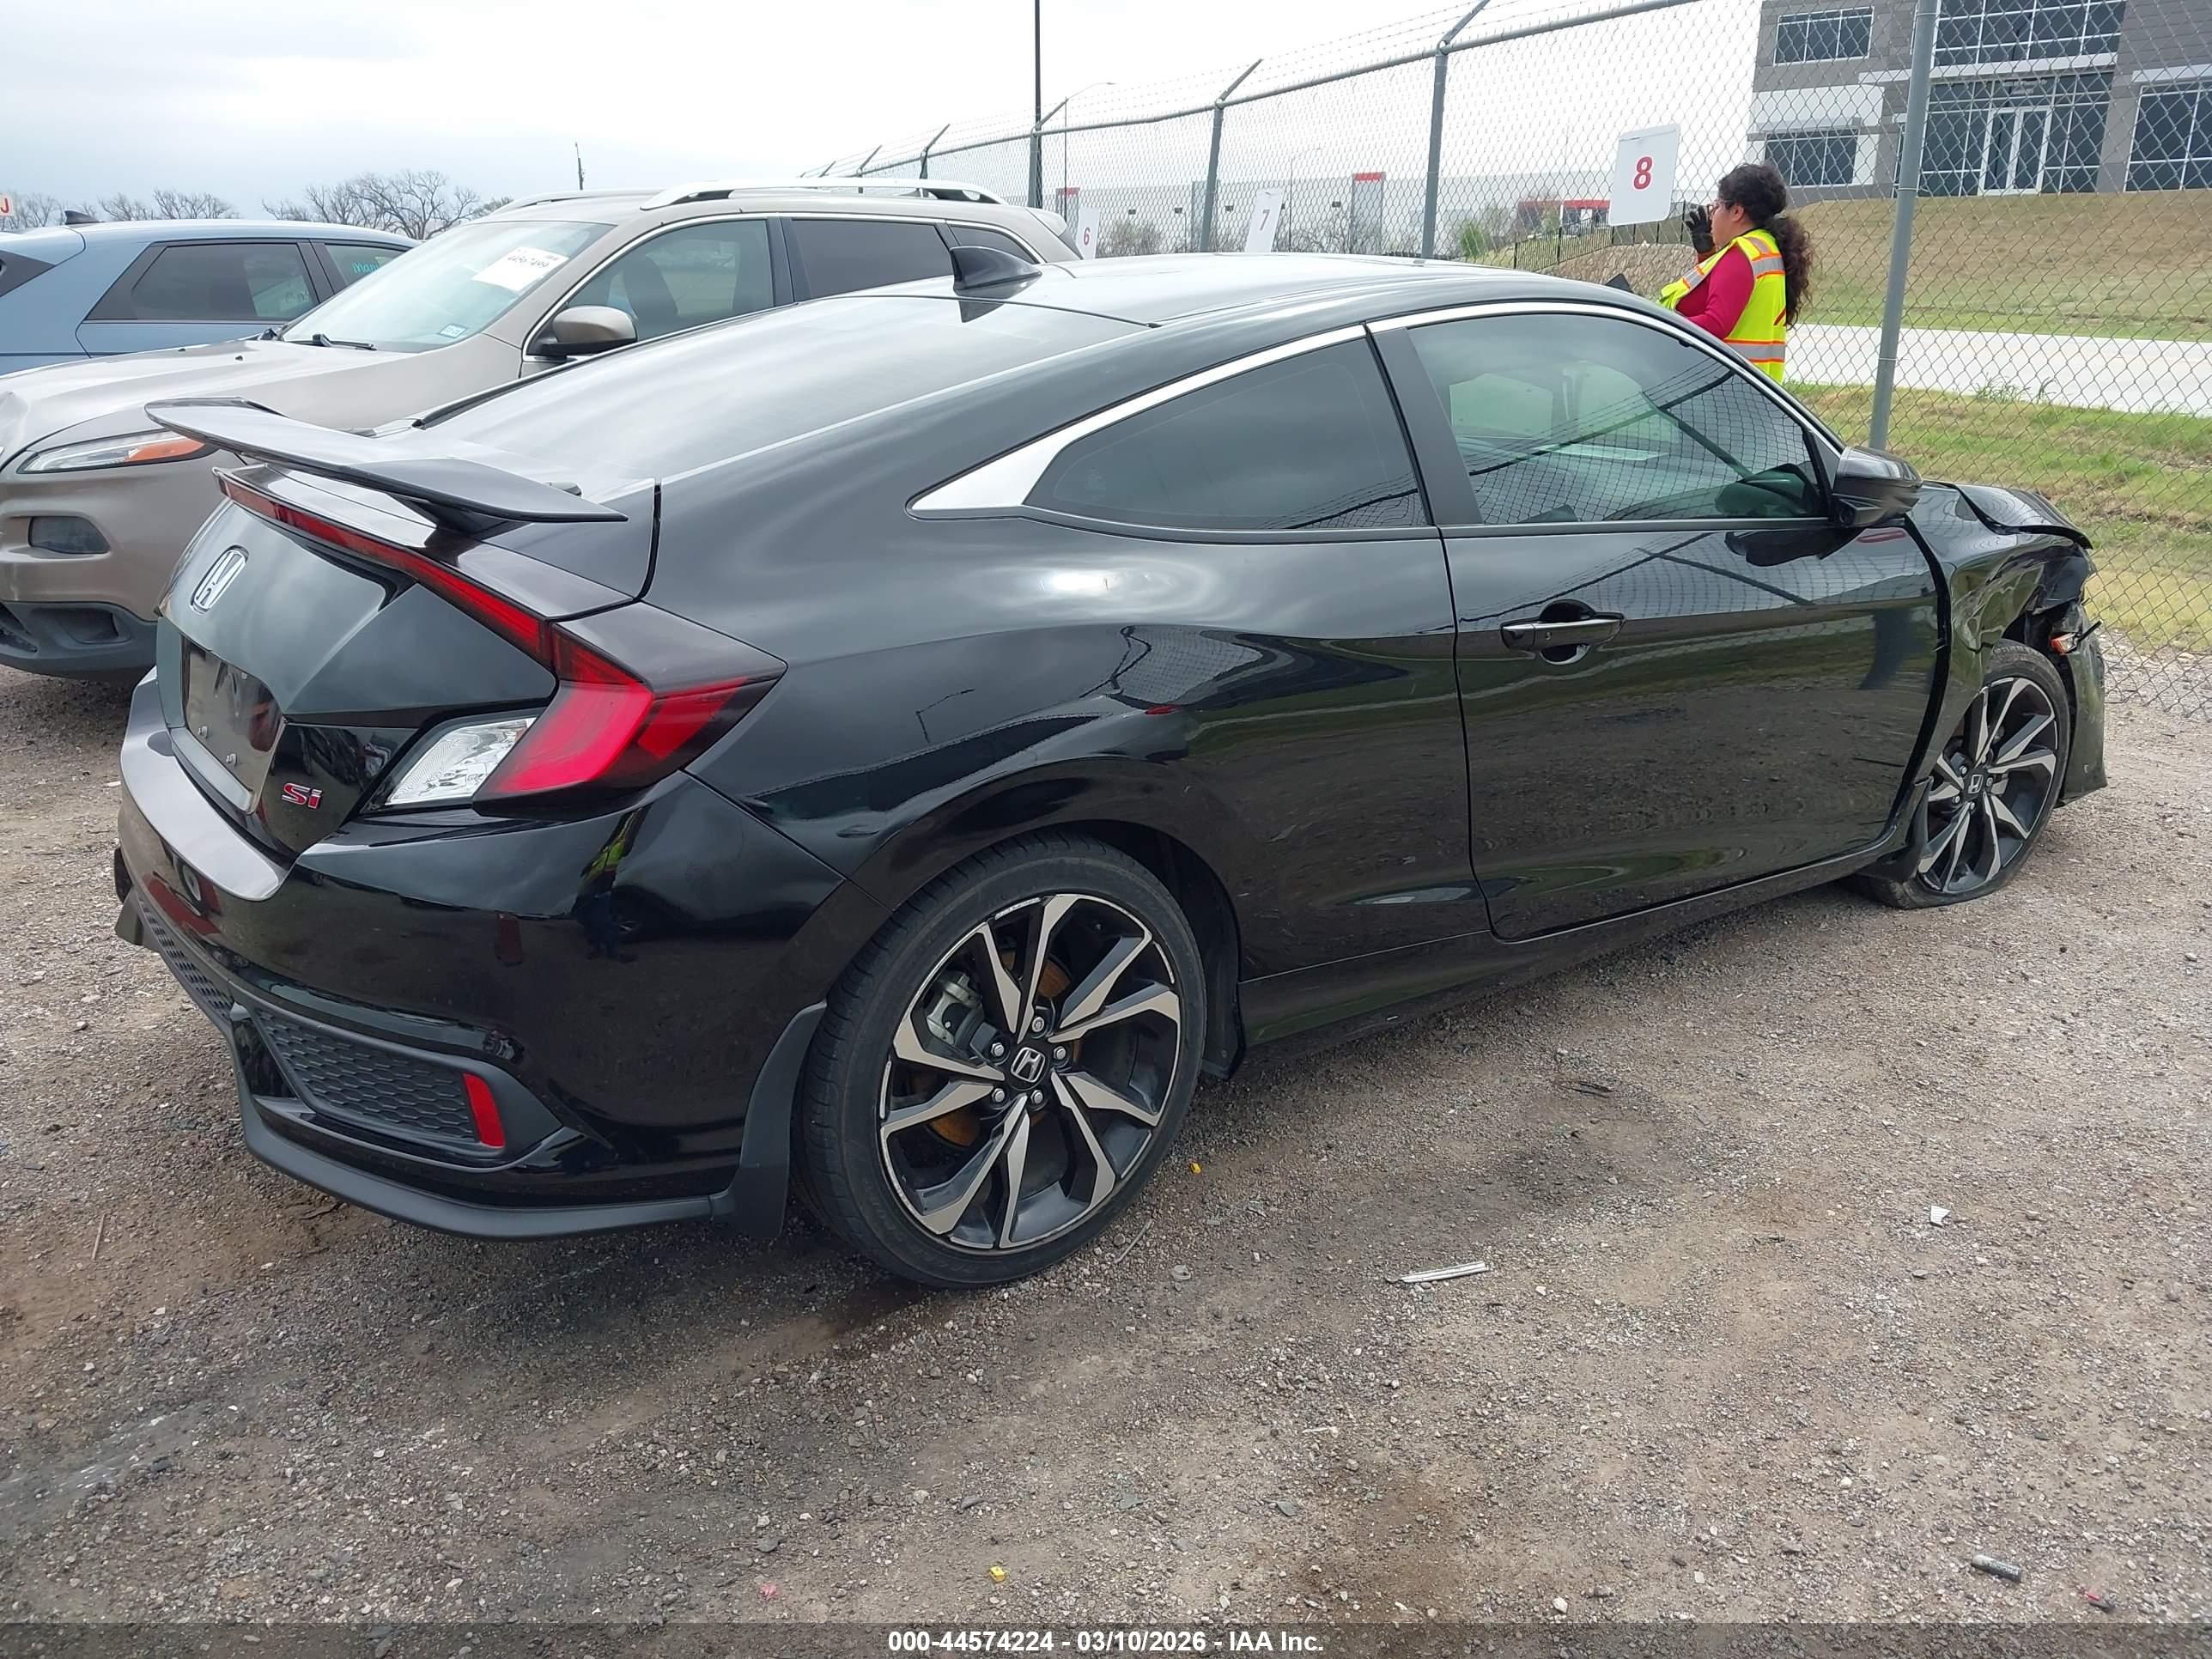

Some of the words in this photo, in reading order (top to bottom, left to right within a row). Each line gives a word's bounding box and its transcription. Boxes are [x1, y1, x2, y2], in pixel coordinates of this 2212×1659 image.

[1633, 155, 1653, 190] 8
[1260, 210, 1271, 231] 7
[1084, 227, 1091, 246] 6
[281, 782, 323, 809] Si
